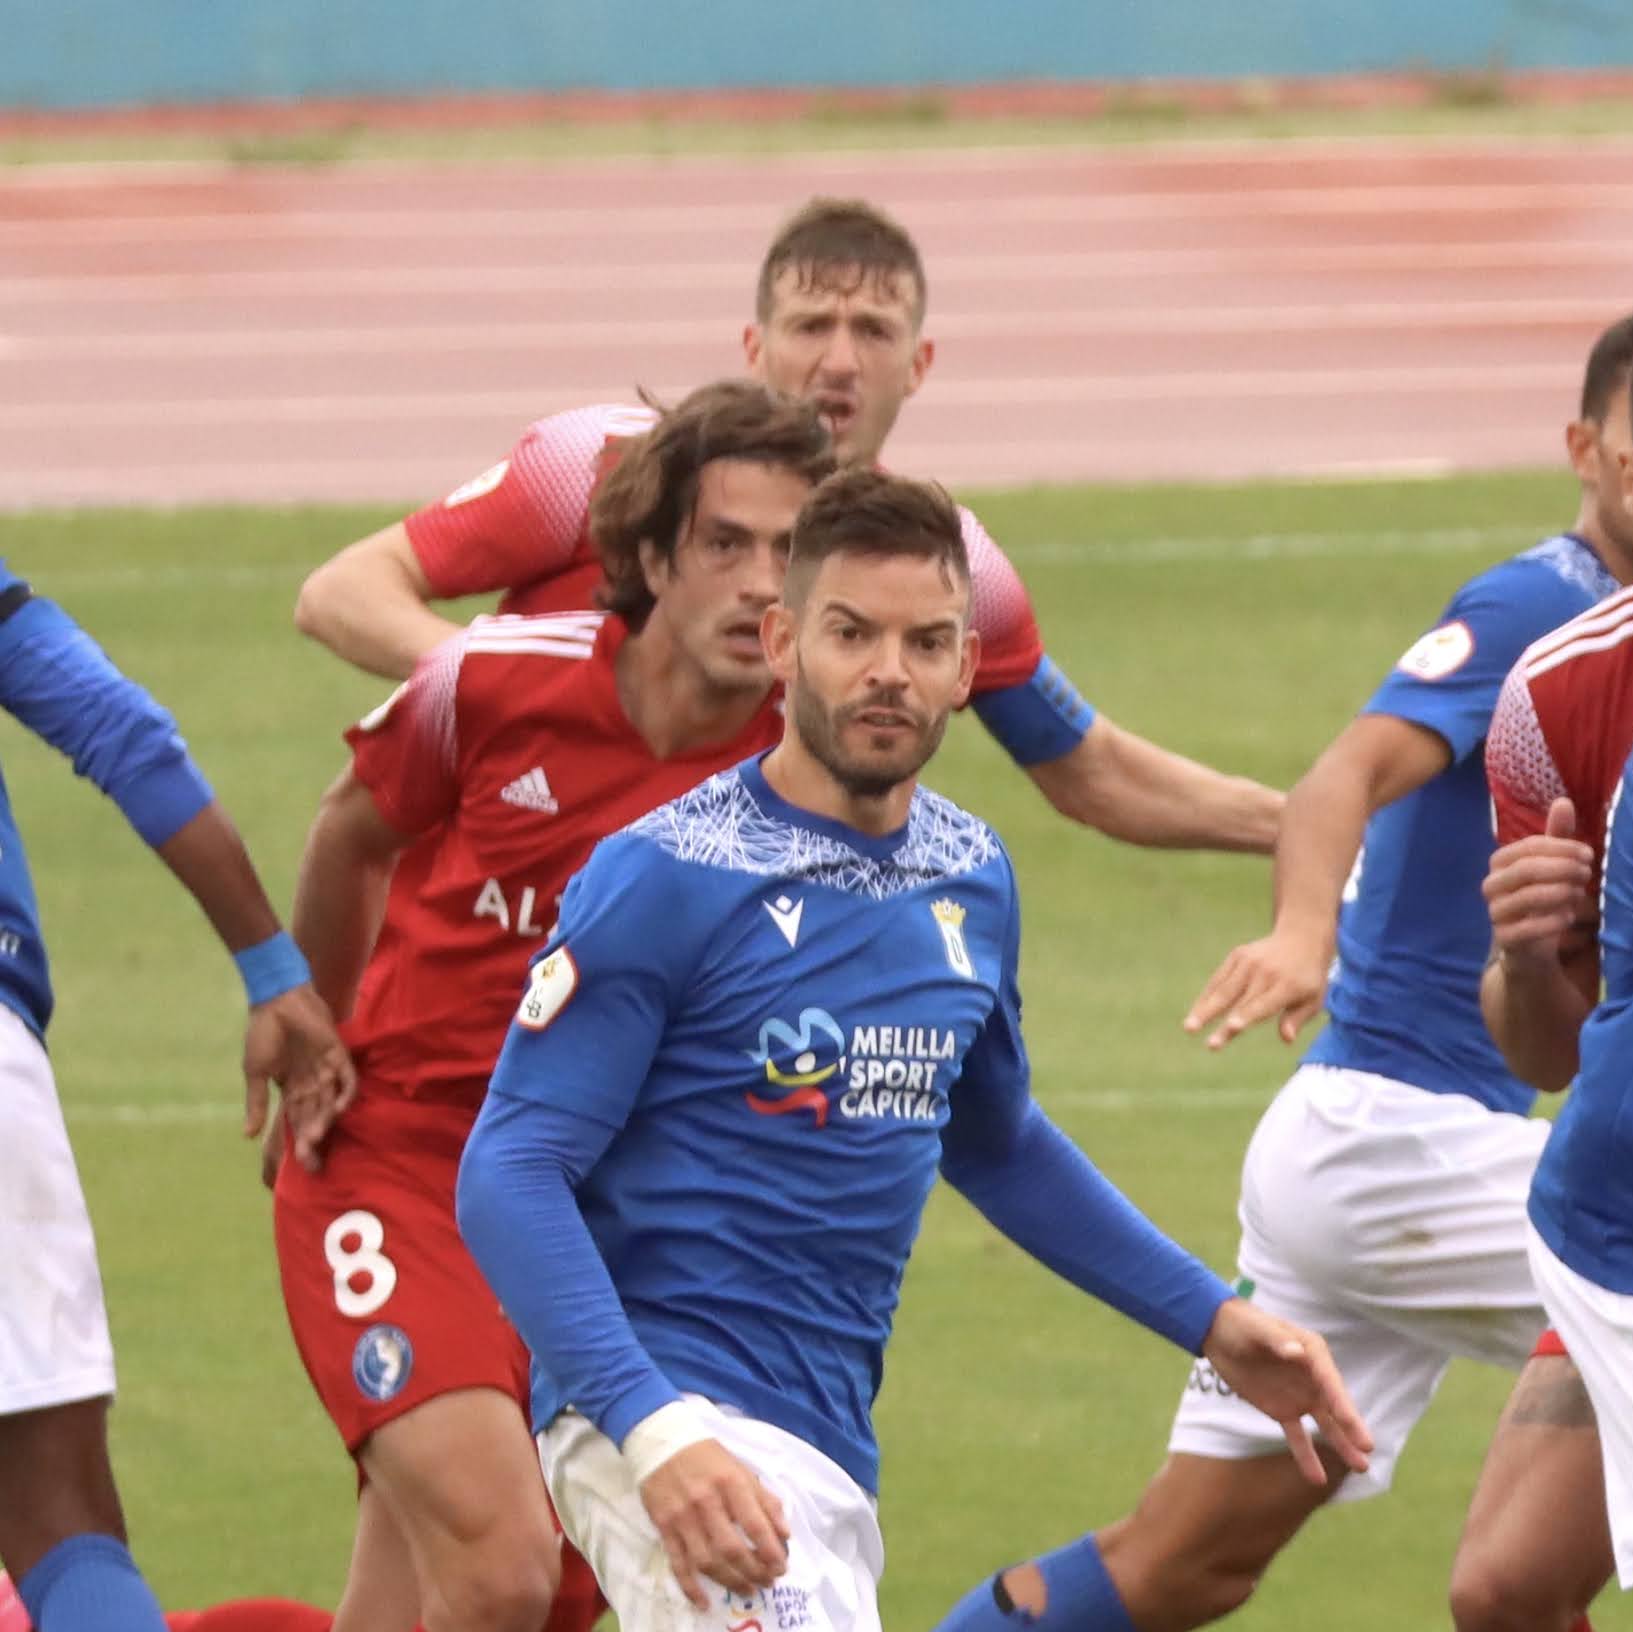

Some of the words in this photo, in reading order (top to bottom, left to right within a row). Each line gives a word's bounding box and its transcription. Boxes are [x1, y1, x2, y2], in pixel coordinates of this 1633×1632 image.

[851, 1025, 955, 1058] MELILLA
[850, 1058, 937, 1091] SPORT
[323, 1208, 398, 1319] 8
